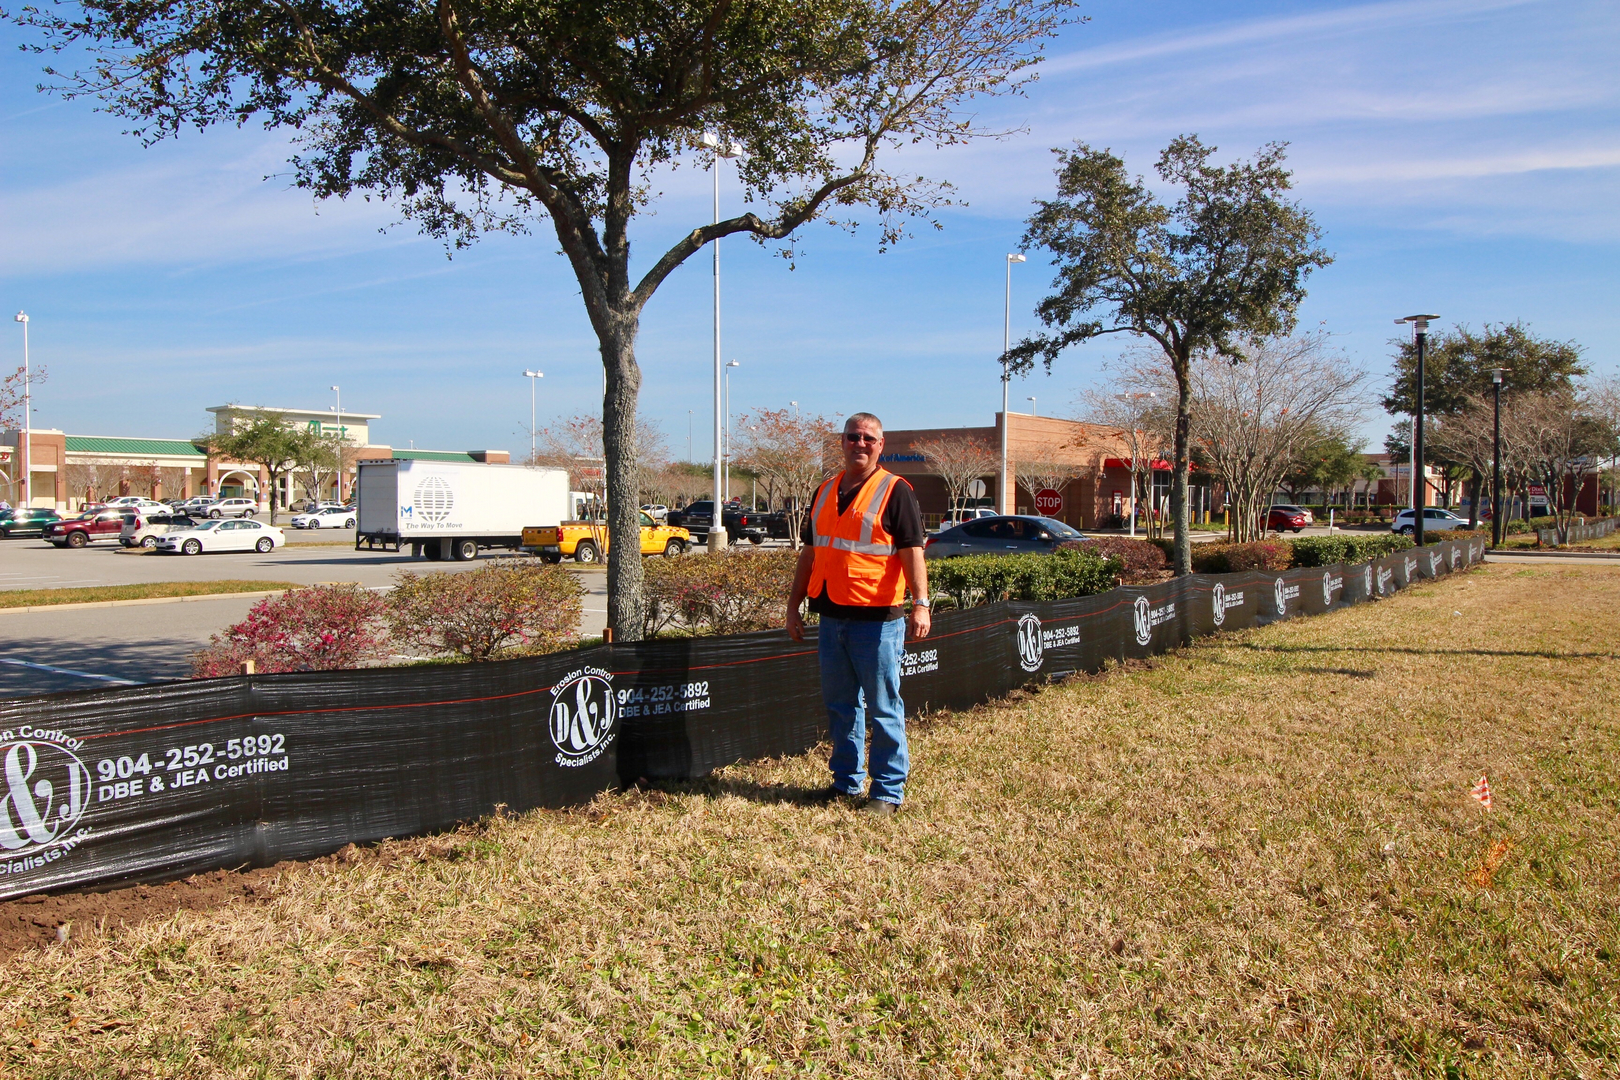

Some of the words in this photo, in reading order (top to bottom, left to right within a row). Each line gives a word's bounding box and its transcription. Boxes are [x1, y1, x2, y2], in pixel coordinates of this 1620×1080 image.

[1036, 496, 1061, 508] STOP
[405, 522, 419, 530] The
[420, 522, 435, 530] Way
[549, 669, 582, 697] Erosion
[583, 665, 614, 682] Control
[905, 666, 916, 676] JEA
[917, 661, 939, 674] Certified
[617, 680, 709, 705] 904-252-5892
[618, 705, 641, 718] DBE
[643, 704, 650, 716] &
[652, 702, 671, 715] JEA
[673, 697, 711, 712] Certified
[20, 725, 84, 752] Control
[97, 733, 286, 782] 904-252-5892
[98, 779, 144, 802] DBE
[150, 775, 165, 793] &
[170, 768, 210, 789] JEA
[214, 756, 289, 780] Certified
